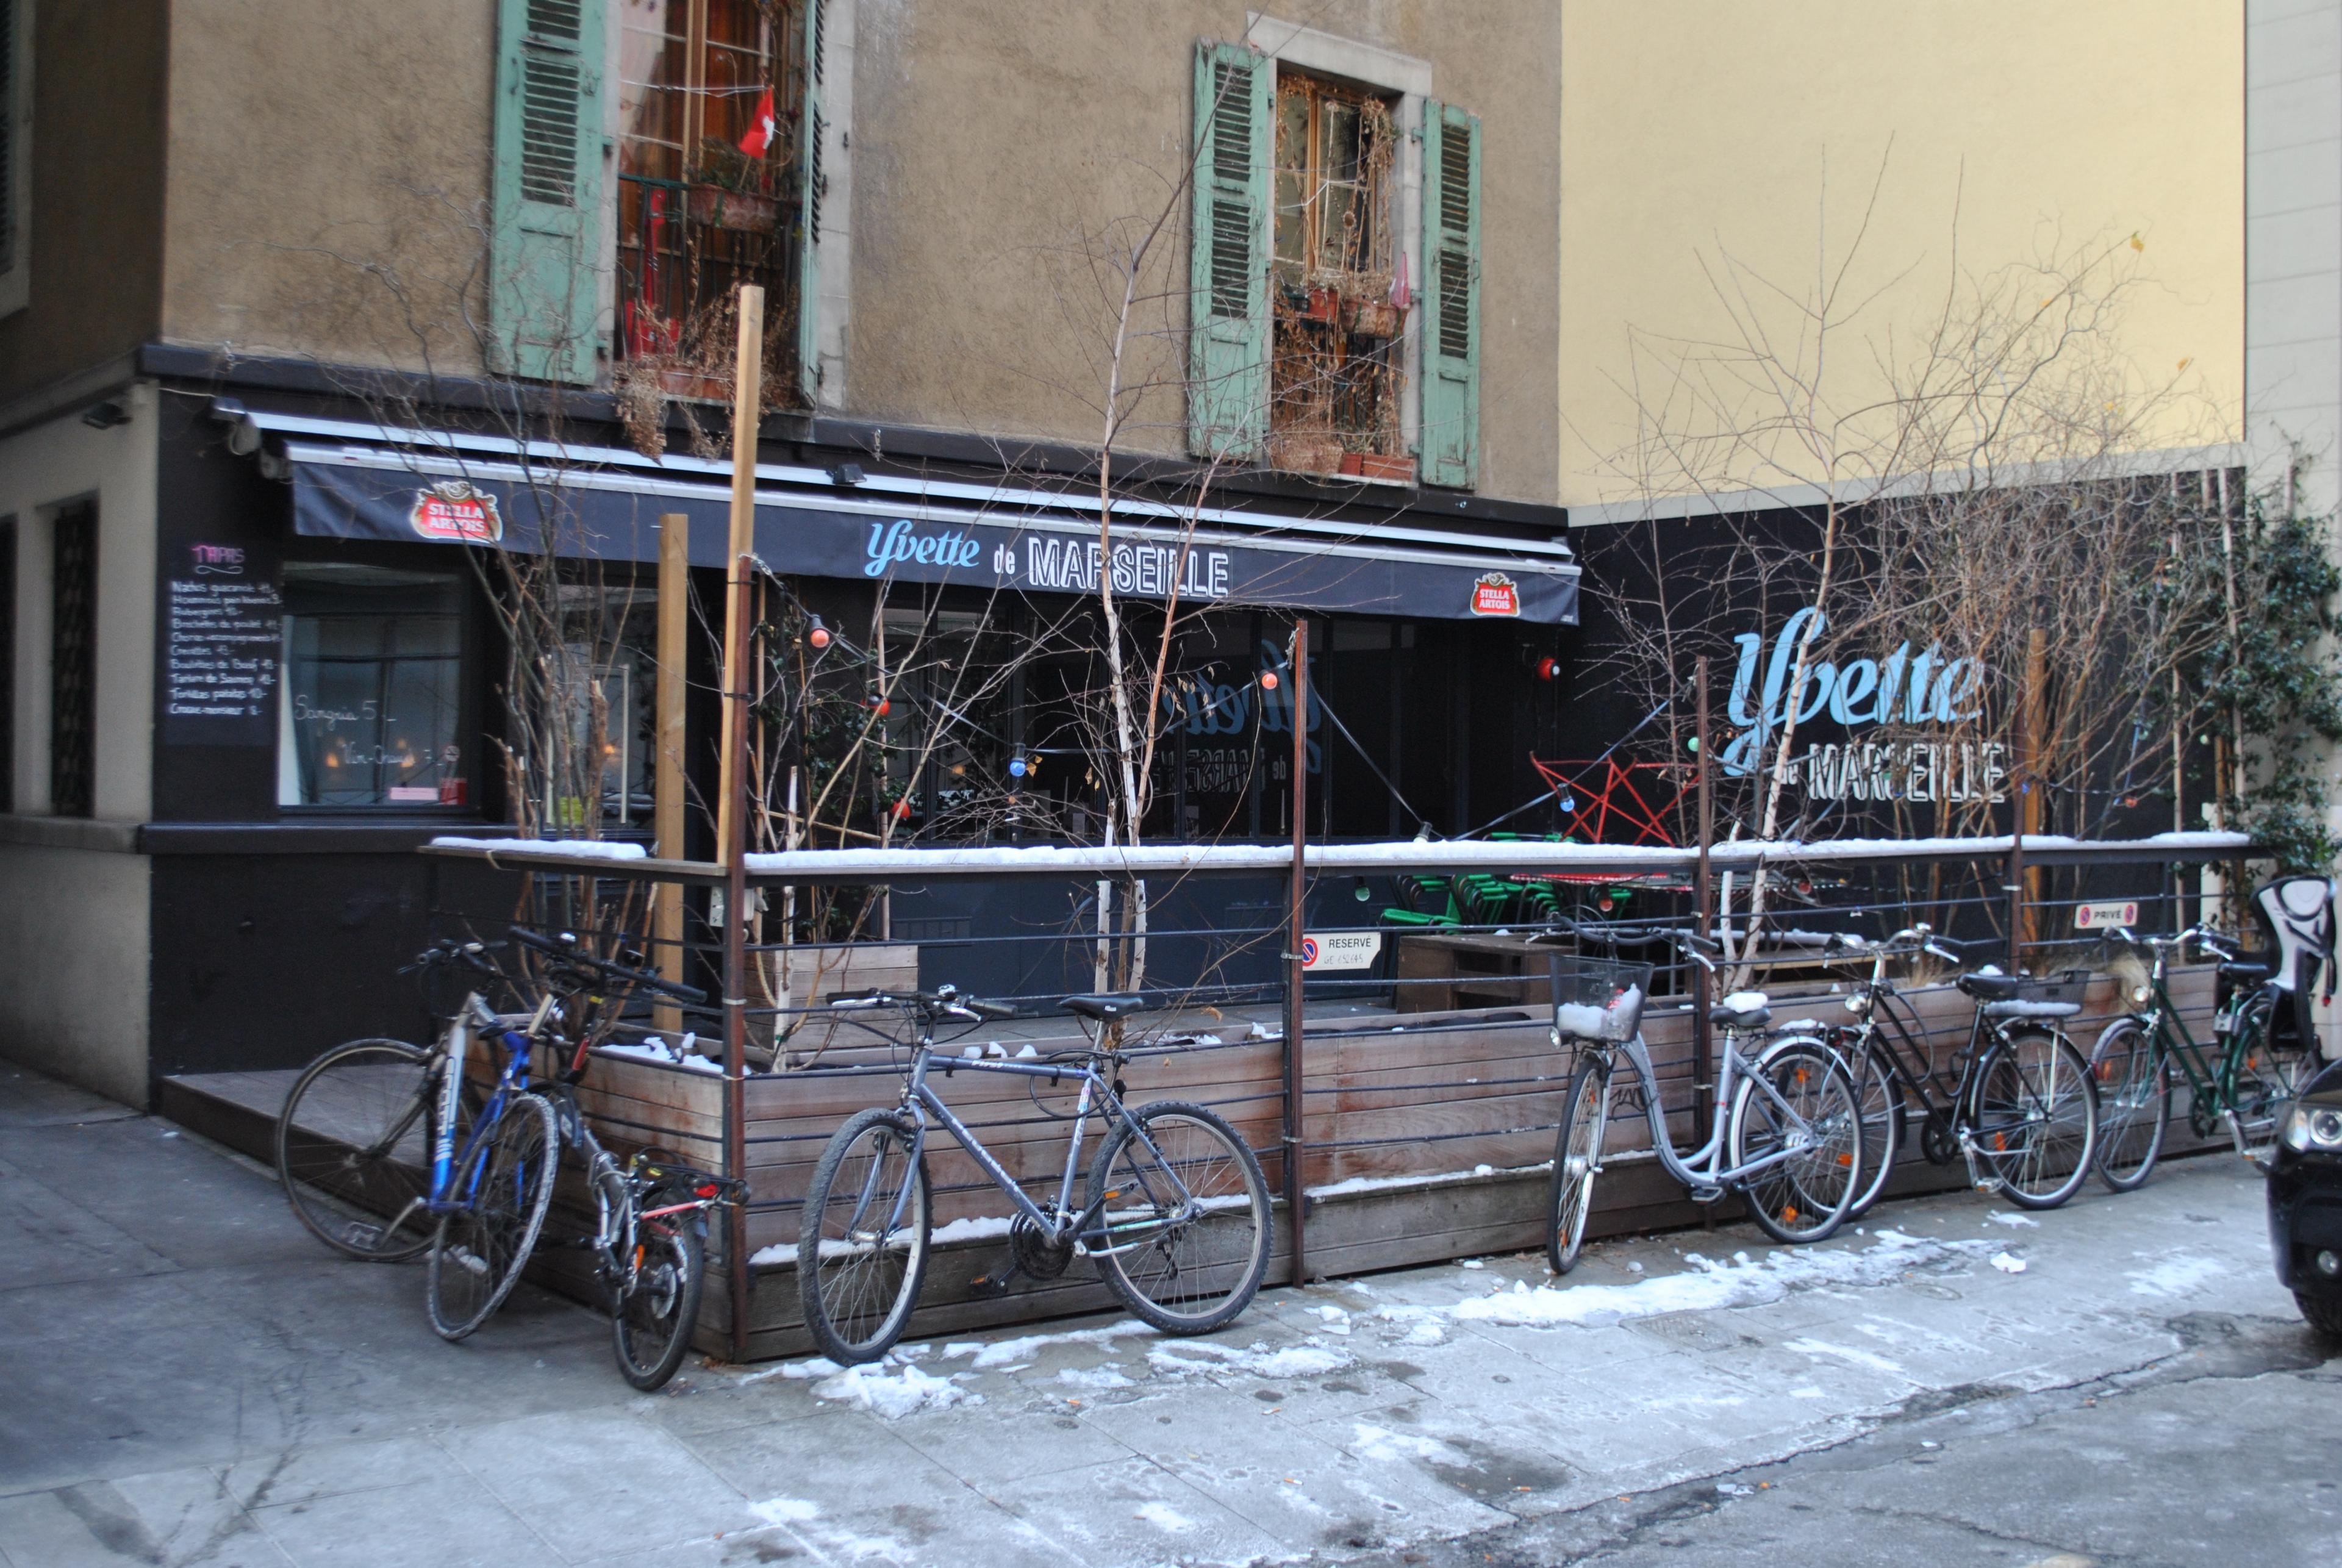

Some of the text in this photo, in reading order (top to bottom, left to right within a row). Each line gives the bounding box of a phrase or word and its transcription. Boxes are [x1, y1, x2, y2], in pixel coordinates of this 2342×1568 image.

[429, 503, 484, 518] STELLA
[429, 518, 484, 532] ARTOIS
[864, 520, 1229, 598] Yvette de MARSEILLE
[1480, 589, 1509, 600] STELLA
[1479, 599, 1510, 609] ARTOIS
[1723, 606, 1985, 776] Yvette
[295, 695, 358, 731] Sangria
[1809, 742, 2005, 804] MARSEILLE
[2094, 908, 2121, 920] PRIVÉ
[1329, 935, 1371, 948] RESERVÉ
